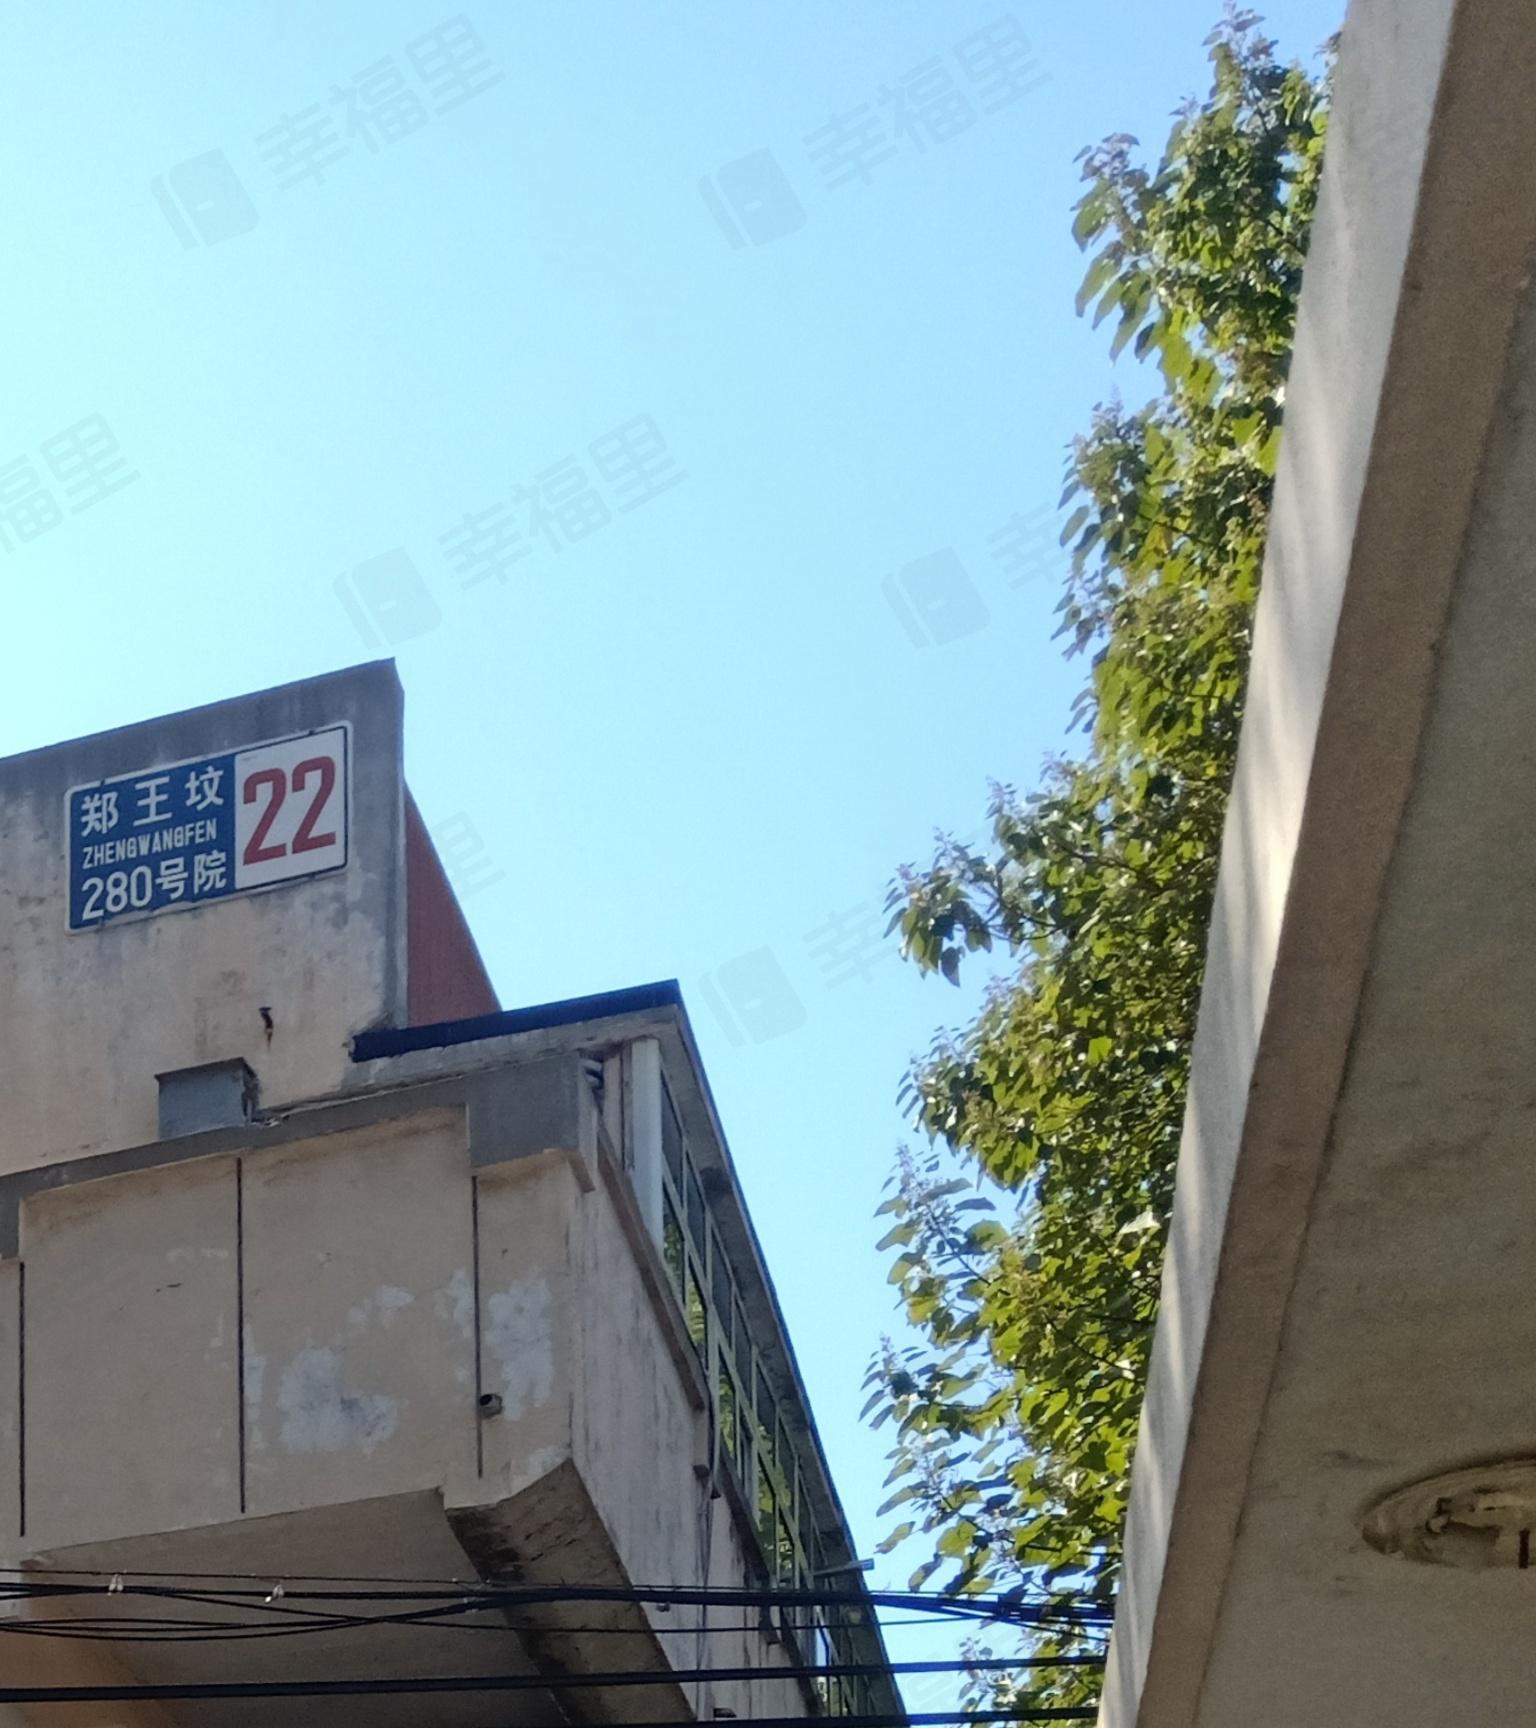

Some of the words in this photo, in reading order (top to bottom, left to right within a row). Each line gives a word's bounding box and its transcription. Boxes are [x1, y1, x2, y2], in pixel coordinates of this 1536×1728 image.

[80, 765, 225, 838] 郑王坟
[242, 755, 337, 866] 22
[82, 818, 218, 870] ZHENGWANGFEN
[81, 849, 227, 921] 280号院
